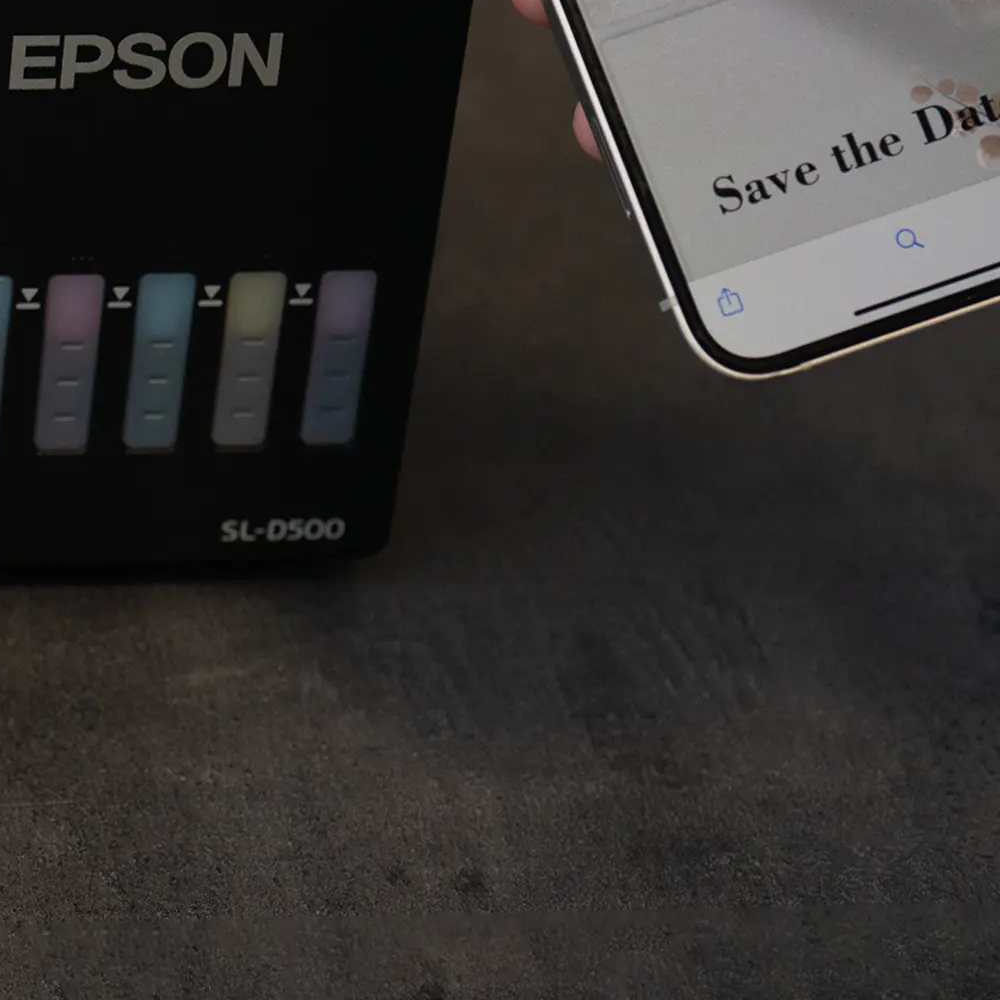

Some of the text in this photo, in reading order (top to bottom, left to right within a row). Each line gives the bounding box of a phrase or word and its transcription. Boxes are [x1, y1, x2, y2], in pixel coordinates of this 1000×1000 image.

[9, 32, 284, 90] EPSON
[713, 94, 1000, 215] Save the Dat
[220, 518, 347, 543] SL-D500
